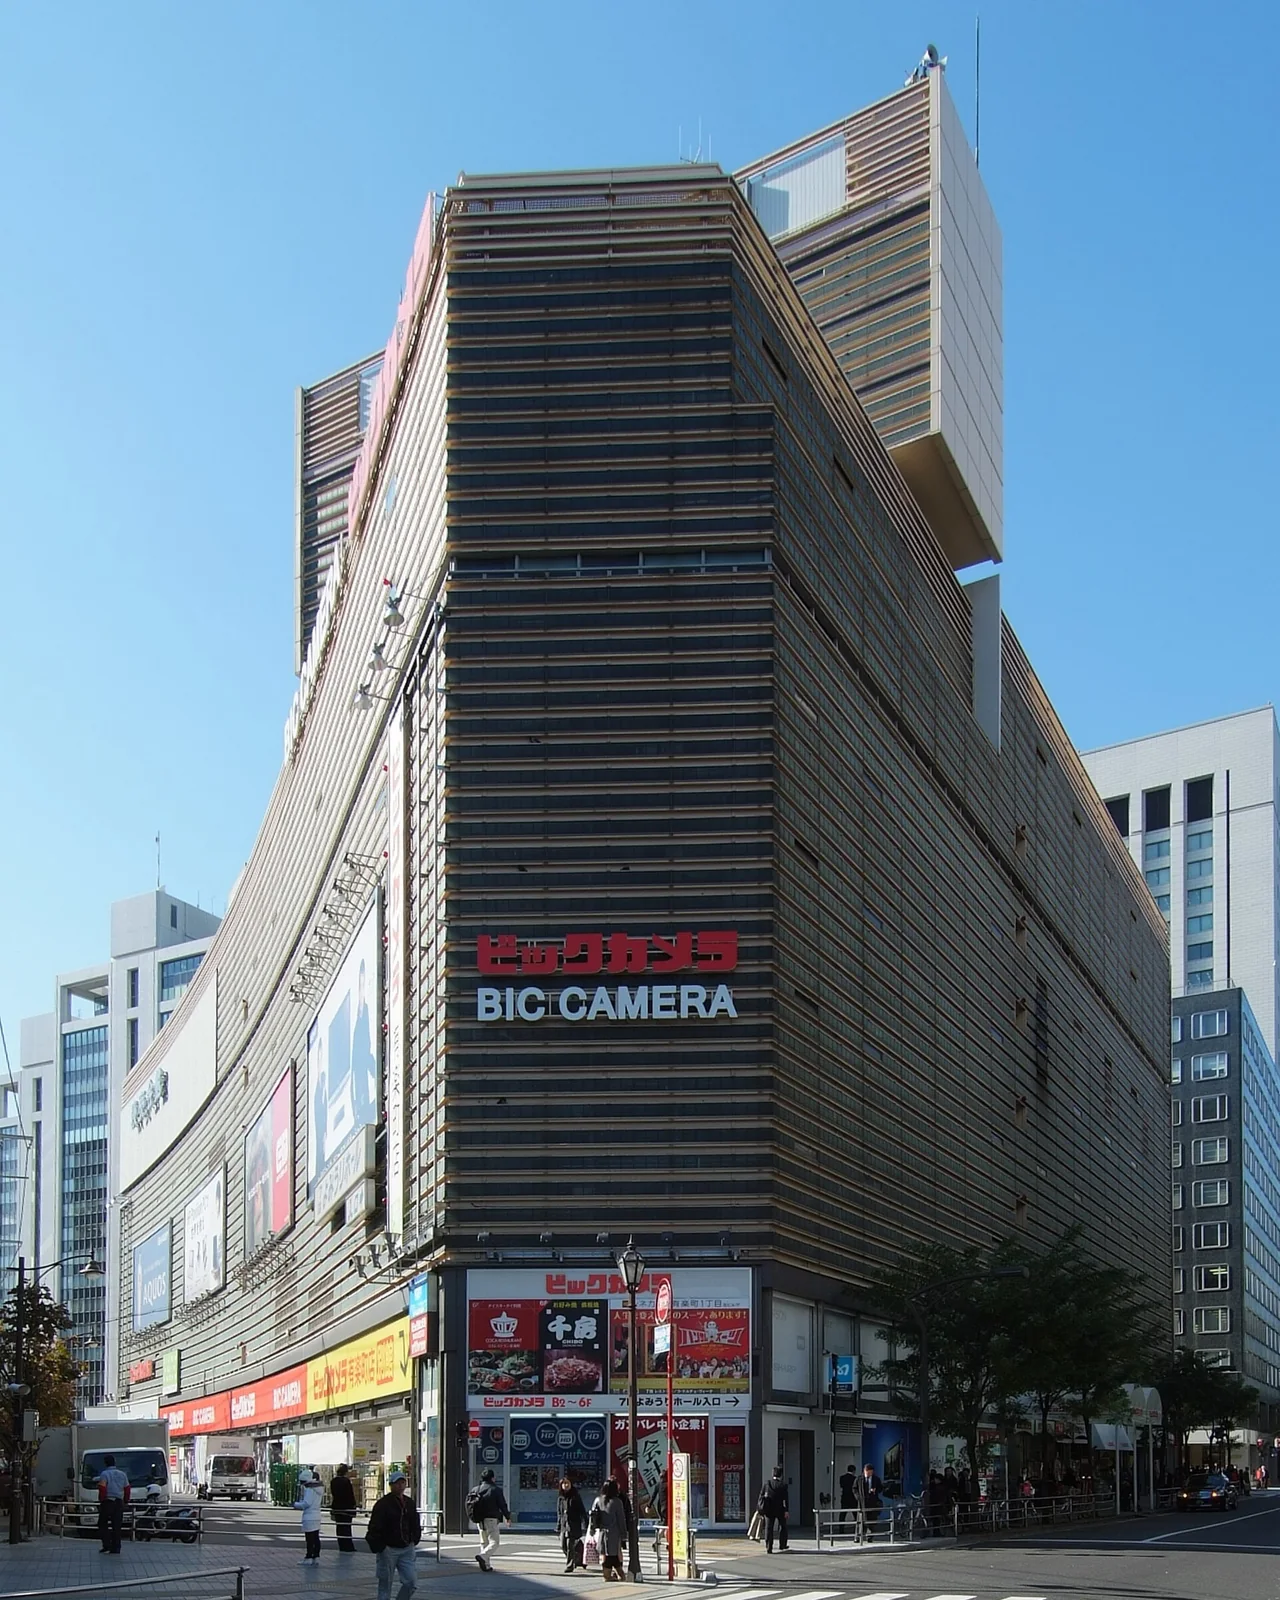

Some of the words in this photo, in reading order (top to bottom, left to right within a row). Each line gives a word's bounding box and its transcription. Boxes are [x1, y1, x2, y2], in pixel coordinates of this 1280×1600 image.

[477, 931, 738, 974] ビックカメラ
[477, 987, 545, 1021] BIC
[558, 984, 738, 1020] CAMERA
[143, 1271, 166, 1306] AQUOS
[548, 1315, 597, 1341] 千房
[483, 1397, 545, 1408] ビックカメラ
[584, 1432, 600, 1440] HD
[642, 1439, 663, 1488] 会計
